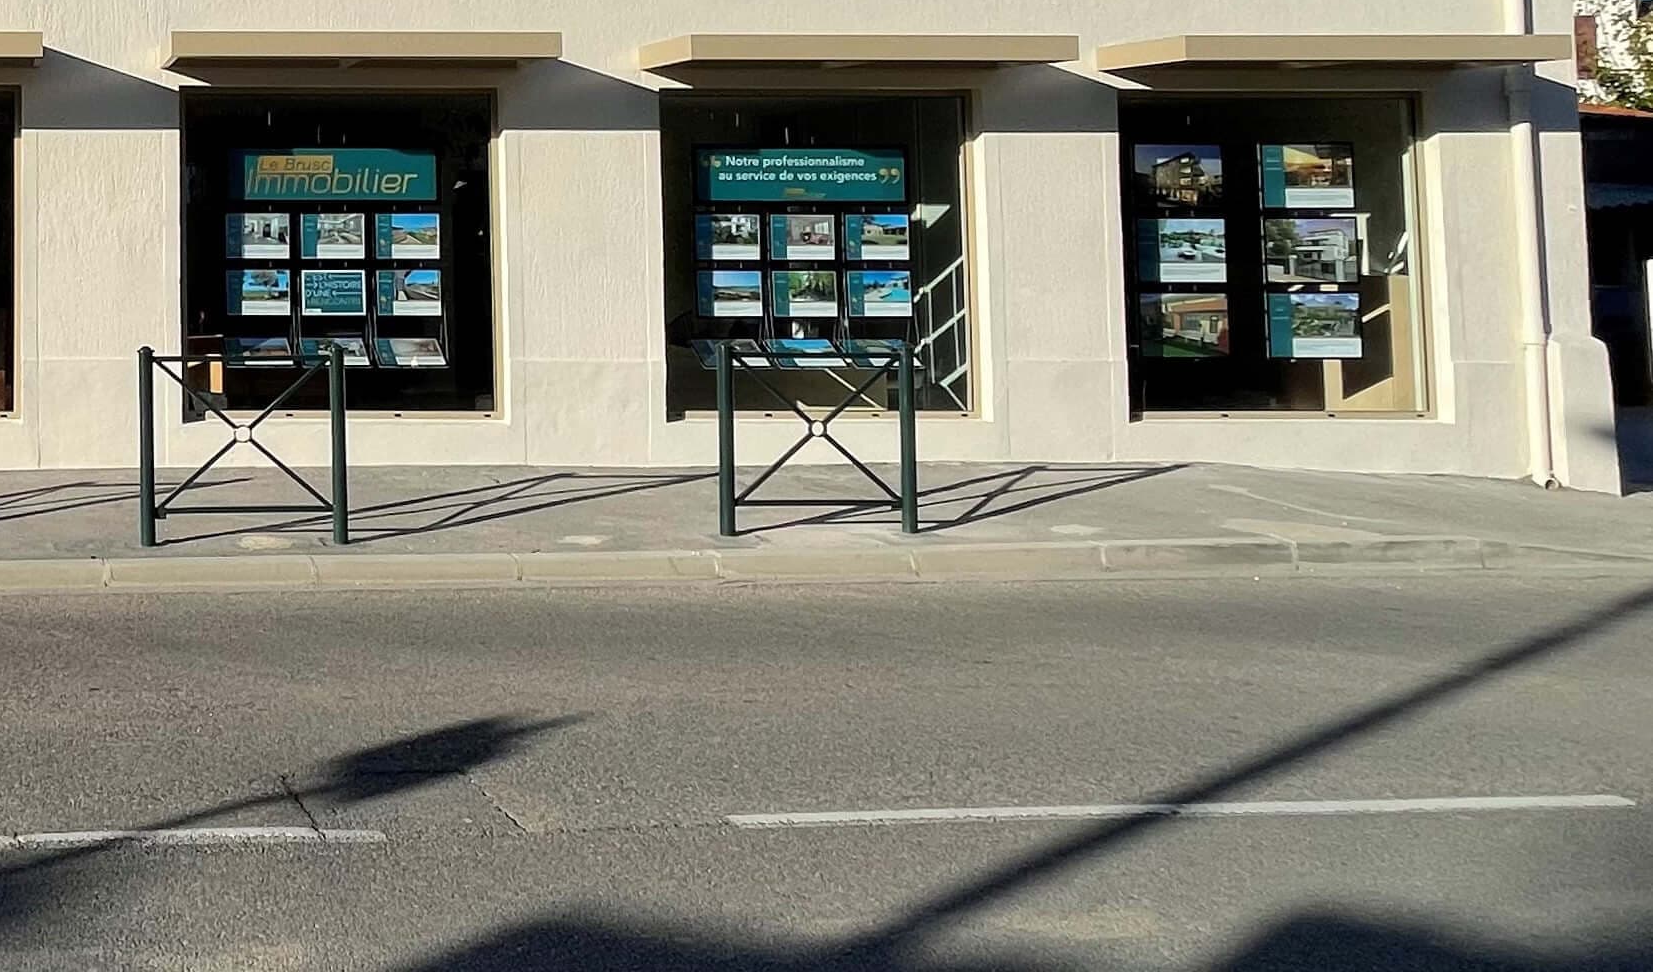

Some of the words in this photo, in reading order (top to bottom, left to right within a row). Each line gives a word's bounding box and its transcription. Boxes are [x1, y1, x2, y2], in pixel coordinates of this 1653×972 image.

[259, 157, 278, 171] Le
[283, 157, 331, 171] Brusc
[725, 155, 760, 167] Notre
[762, 155, 865, 171] professionnalisme
[247, 167, 419, 195] Immobilier
[718, 171, 732, 181] au
[735, 170, 775, 181] service
[778, 169, 794, 181] de
[796, 171, 817, 181] vos
[819, 170, 878, 184] exigences
